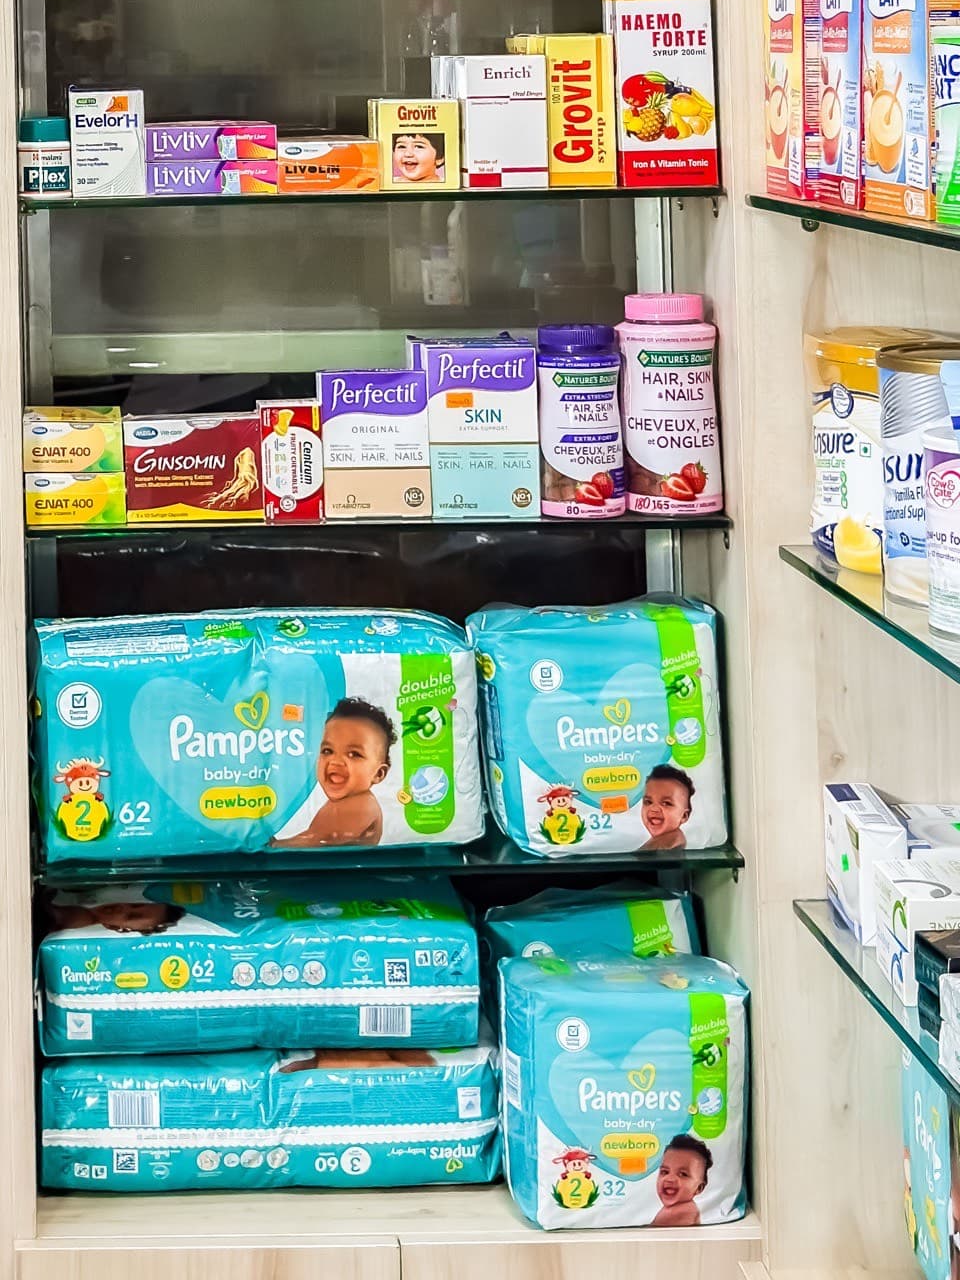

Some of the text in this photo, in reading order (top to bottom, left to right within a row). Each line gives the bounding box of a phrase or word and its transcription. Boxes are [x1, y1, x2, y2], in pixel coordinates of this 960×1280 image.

[622, 13, 681, 31] HAEMO
[652, 30, 706, 47] FORTE
[484, 67, 531, 80] Enrich
[398, 105, 436, 121] Grovit
[553, 60, 593, 163] Grovit
[75, 114, 138, 128] Evelor H
[598, 117, 606, 163] syrup
[285, 166, 340, 175] LIVOLIN
[633, 159, 709, 168] Iron & Vitamin Tonic
[28, 167, 66, 184] Pilex
[651, 353, 689, 364] NATURE'S
[438, 352, 526, 386] Perfectil
[642, 371, 711, 386] HAIR, SKIN
[665, 388, 704, 401] NAILS
[464, 409, 502, 423] SKIN
[628, 417, 700, 433] CHEVEUX,
[657, 435, 715, 449] ONGLES
[32, 447, 91, 457] ENAT 400
[134, 449, 226, 472] GINSOMIN
[302, 441, 312, 485] Centrum
[566, 506, 579, 515] 80
[401, 673, 452, 694] double
[398, 685, 455, 705] protection
[170, 714, 305, 764] Pampers
[557, 717, 658, 750] Pampers
[204, 765, 272, 782] baby-dry
[204, 794, 272, 810] newborn
[119, 802, 151, 824] 62
[589, 814, 612, 829] 32
[579, 1078, 681, 1116] Pampers
[604, 1139, 656, 1150] newborn
